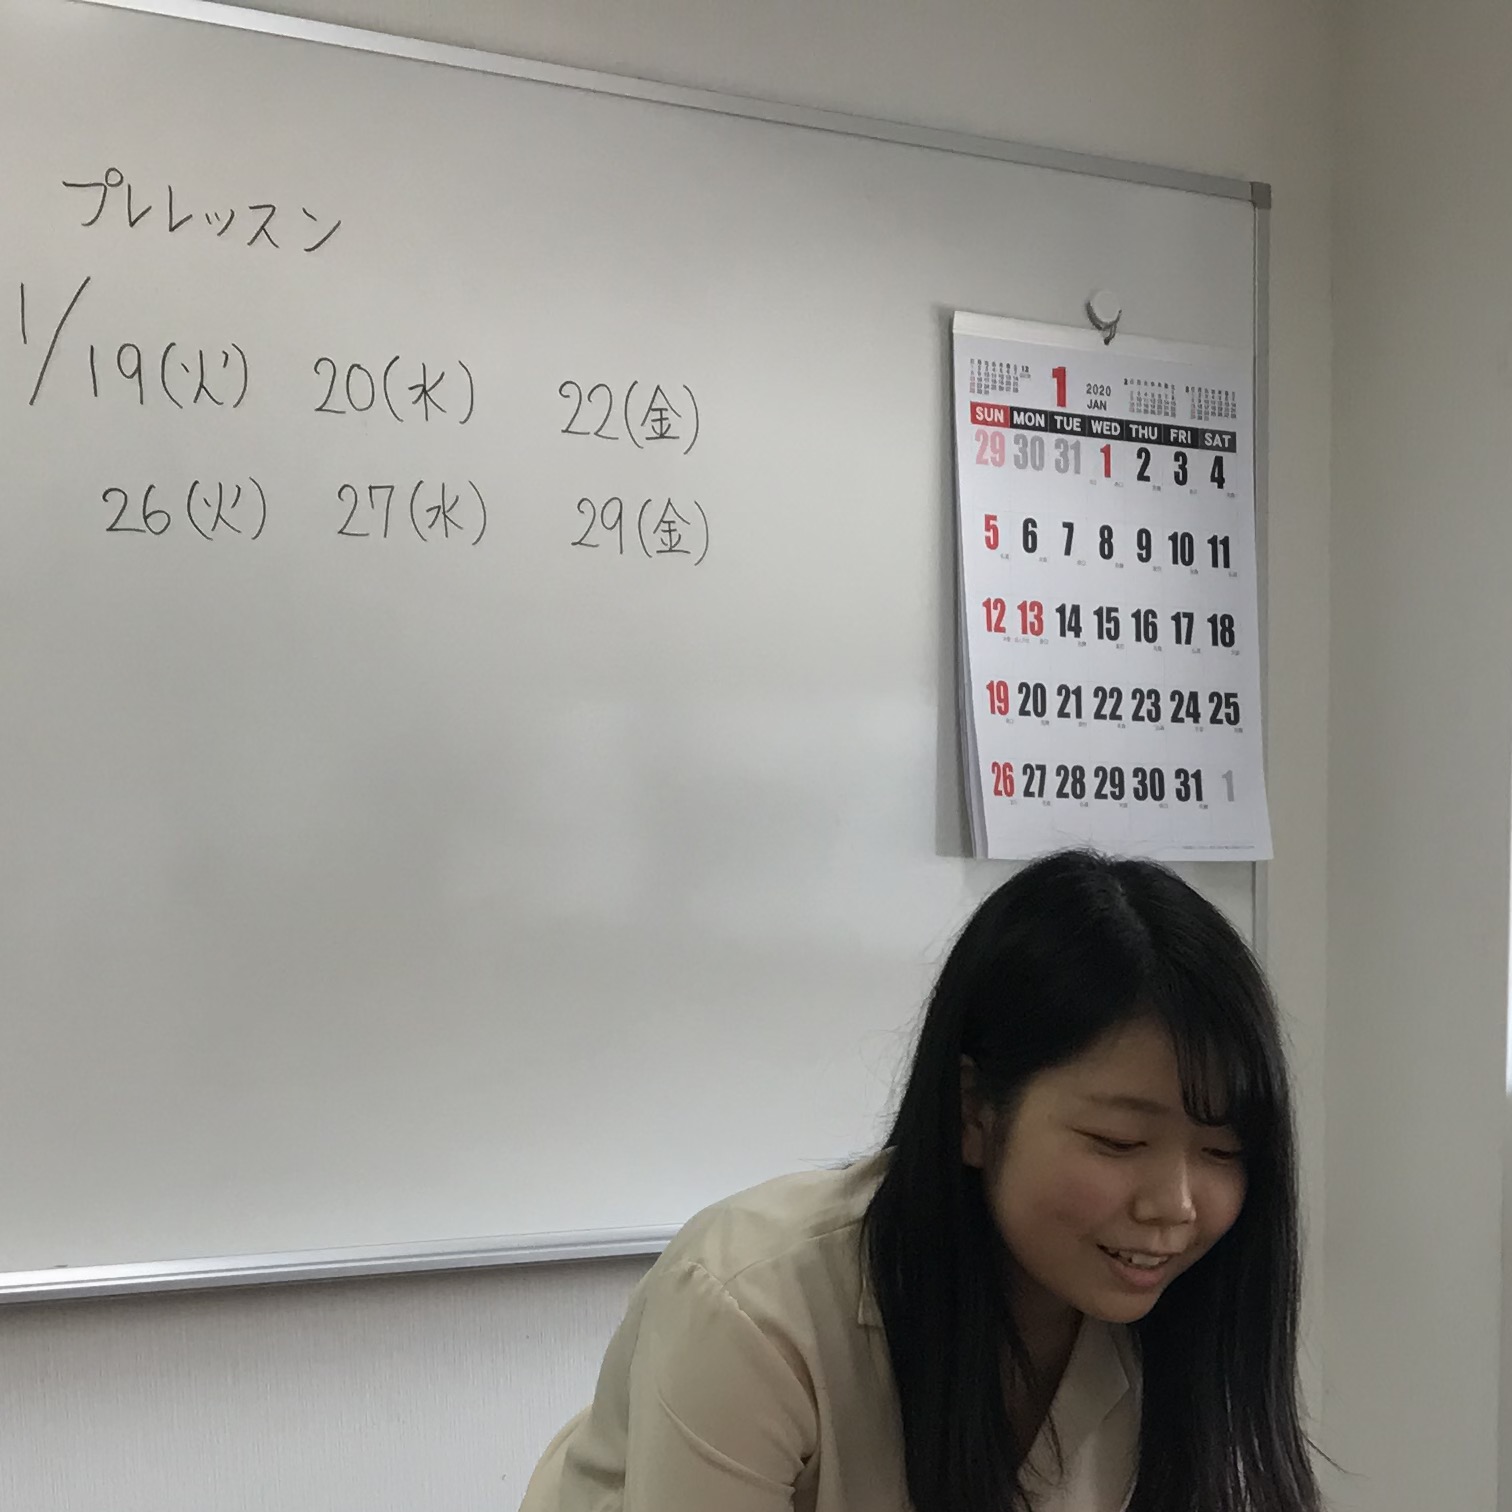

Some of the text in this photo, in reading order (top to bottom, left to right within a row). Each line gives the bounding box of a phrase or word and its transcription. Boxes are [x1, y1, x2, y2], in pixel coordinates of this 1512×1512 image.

[62, 167, 342, 253] プレレッスン
[314, 355, 476, 426] 20(水)
[559, 380, 700, 455] 22(金)
[1052, 366, 1067, 408] 1
[1086, 383, 1112, 398] 2020
[1086, 399, 1107, 412] JAN
[975, 405, 1231, 448] SUN MON TUE WED THU FRI SAT
[974, 428, 1006, 467] 29
[1013, 433, 1045, 471] 30
[1054, 437, 1082, 475] 31
[1100, 443, 1111, 478] 1
[1136, 447, 1151, 482] 2
[1173, 450, 1188, 486] 3
[1210, 455, 1226, 489] 4
[102, 476, 710, 566] 26(火) 27(水) 29(金)
[984, 513, 999, 550] 5
[1022, 517, 1038, 553] 6
[1062, 521, 1074, 556] 7
[1099, 524, 1114, 560] 8
[1136, 528, 1152, 563] 9
[1168, 531, 1194, 567] 10
[1207, 534, 1231, 569] 11
[982, 597, 1007, 634] 12
[1016, 600, 1044, 637] 13
[1055, 603, 1083, 638] 14
[1093, 606, 1120, 641] 15
[1131, 608, 1158, 644] 16
[1171, 611, 1195, 645] 17
[1206, 613, 1235, 648] 18
[985, 680, 1009, 716] 19
[1017, 682, 1047, 718] 20
[1056, 684, 1082, 719] 21
[1093, 686, 1123, 721] 22
[1131, 688, 1161, 723] 23
[1170, 690, 1200, 724] 24
[1208, 691, 1240, 726] 25
[991, 761, 1235, 802] 26 27 28 29 30 31 1
